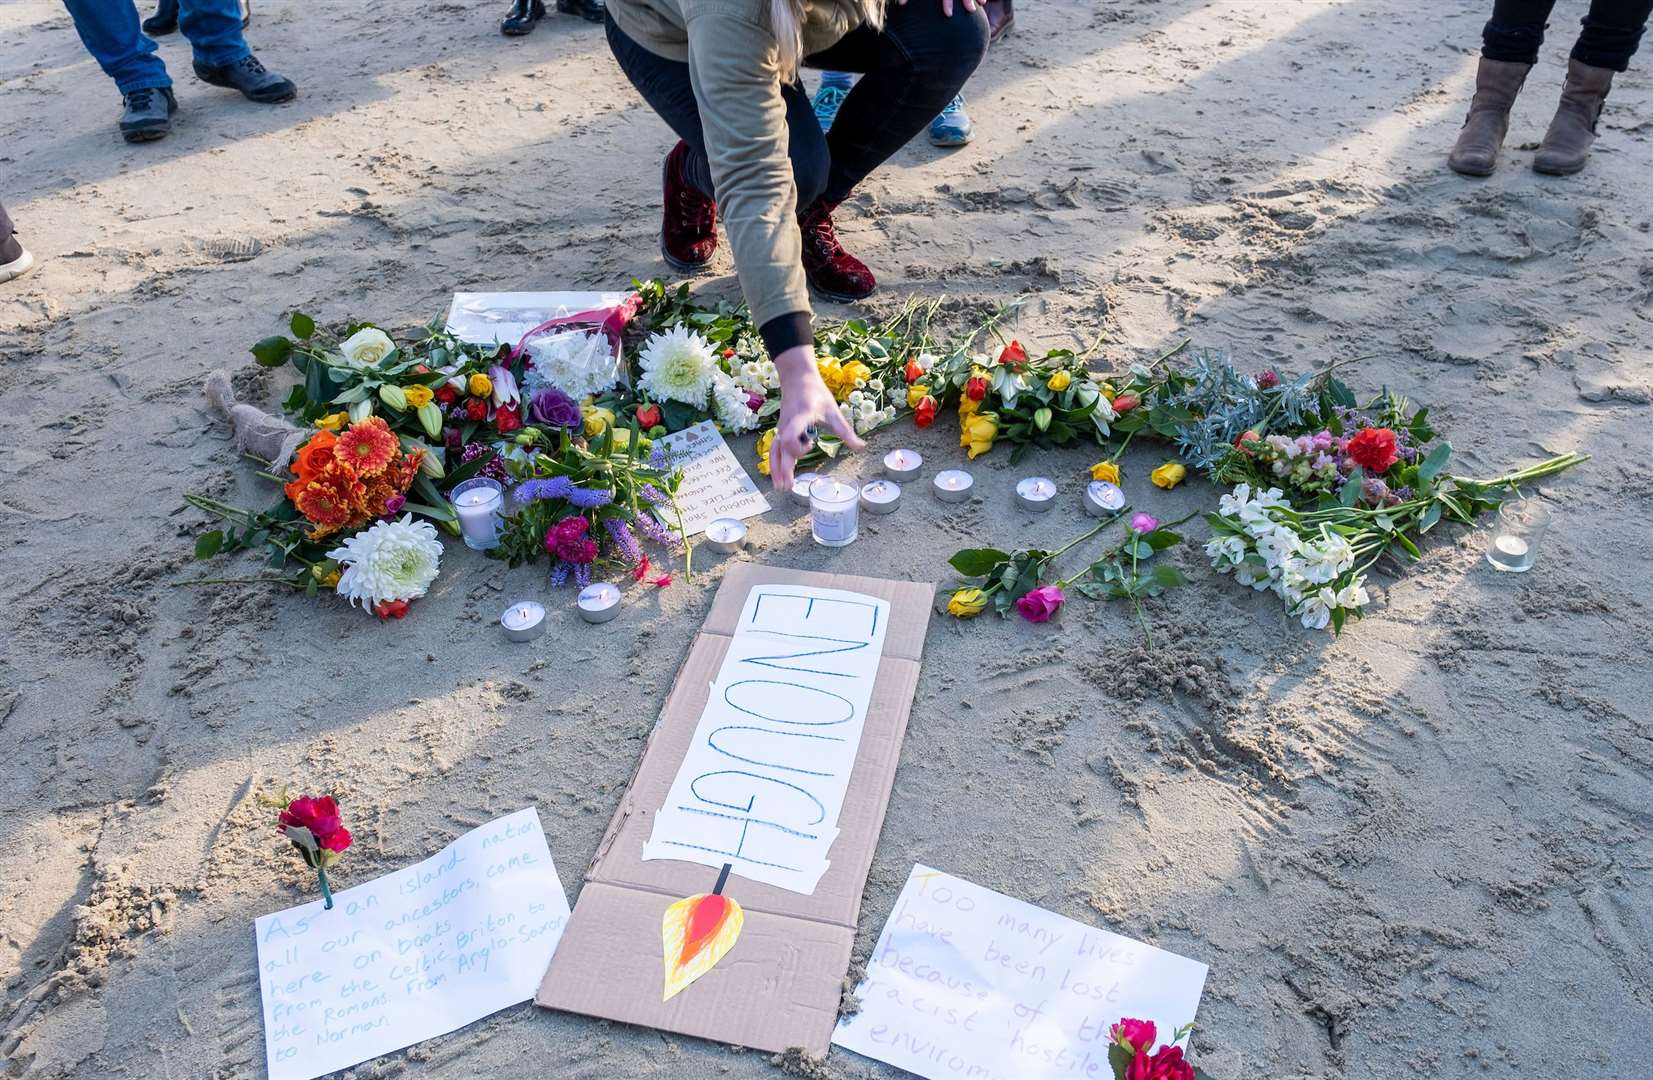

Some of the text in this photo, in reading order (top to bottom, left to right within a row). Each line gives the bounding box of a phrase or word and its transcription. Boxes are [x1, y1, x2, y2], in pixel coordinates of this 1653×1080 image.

[703, 494, 725, 506] LIKE
[662, 593, 878, 872] ENOUGH
[264, 821, 537, 943] As an island nation
[265, 852, 539, 972] all our ancestors, come
[270, 919, 450, 997] here on boats
[273, 1023, 306, 1042] the
[457, 914, 566, 974] Anglo-Saxon
[341, 979, 379, 998] the
[456, 912, 516, 949] Briton
[528, 902, 545, 915] to
[896, 898, 952, 945] have
[985, 940, 1046, 982] been
[998, 913, 1064, 955] many
[866, 980, 978, 1032] racist
[879, 933, 989, 1001] because
[1014, 1000, 1048, 1030] of
[275, 1016, 390, 1062] to Norman
